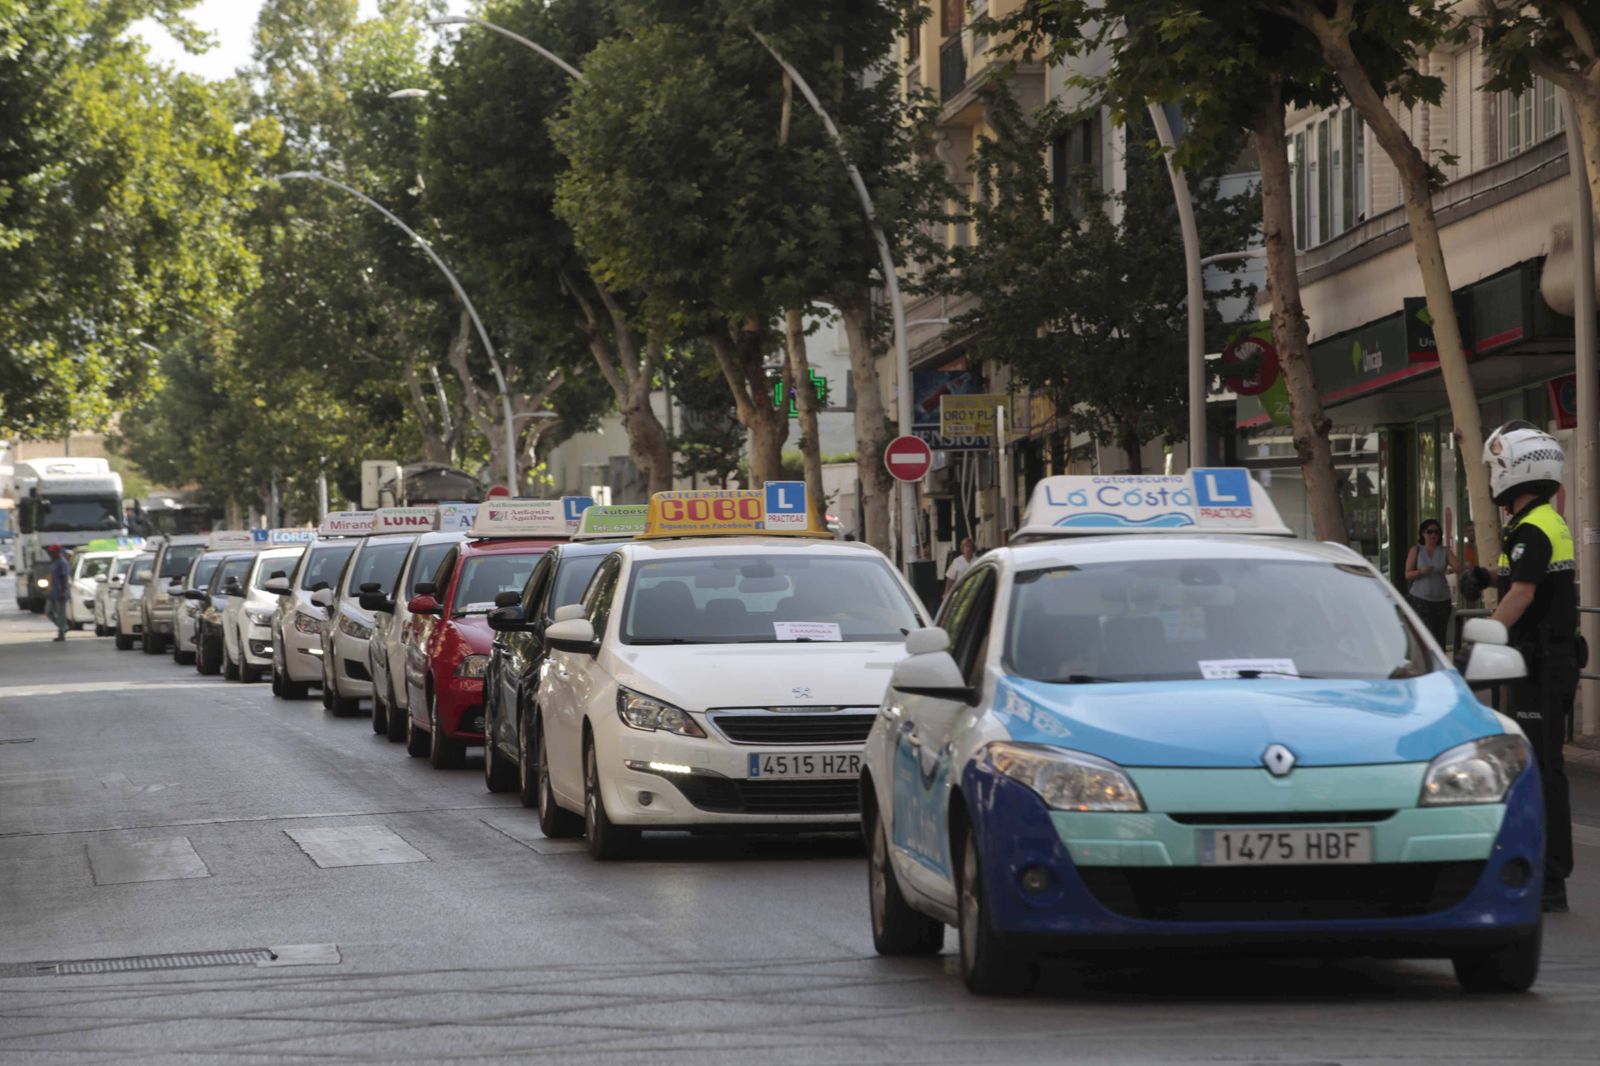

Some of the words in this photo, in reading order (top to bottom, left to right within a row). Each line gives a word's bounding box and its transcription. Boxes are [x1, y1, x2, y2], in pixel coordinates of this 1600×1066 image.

[944, 410, 966, 420] ORO
[969, 410, 975, 419] Y
[1092, 475, 1184, 484] autoescuela
[1205, 474, 1238, 502] L
[778, 488, 794, 509] L
[660, 498, 762, 522] COBO
[1200, 507, 1254, 519] PRACTICAS
[384, 516, 430, 527] LUNA
[767, 514, 805, 523] PRACTICAS
[763, 755, 815, 774] 4515
[822, 755, 861, 774] HZR
[1222, 833, 1294, 861] 1475
[1305, 832, 1360, 860] HBF
